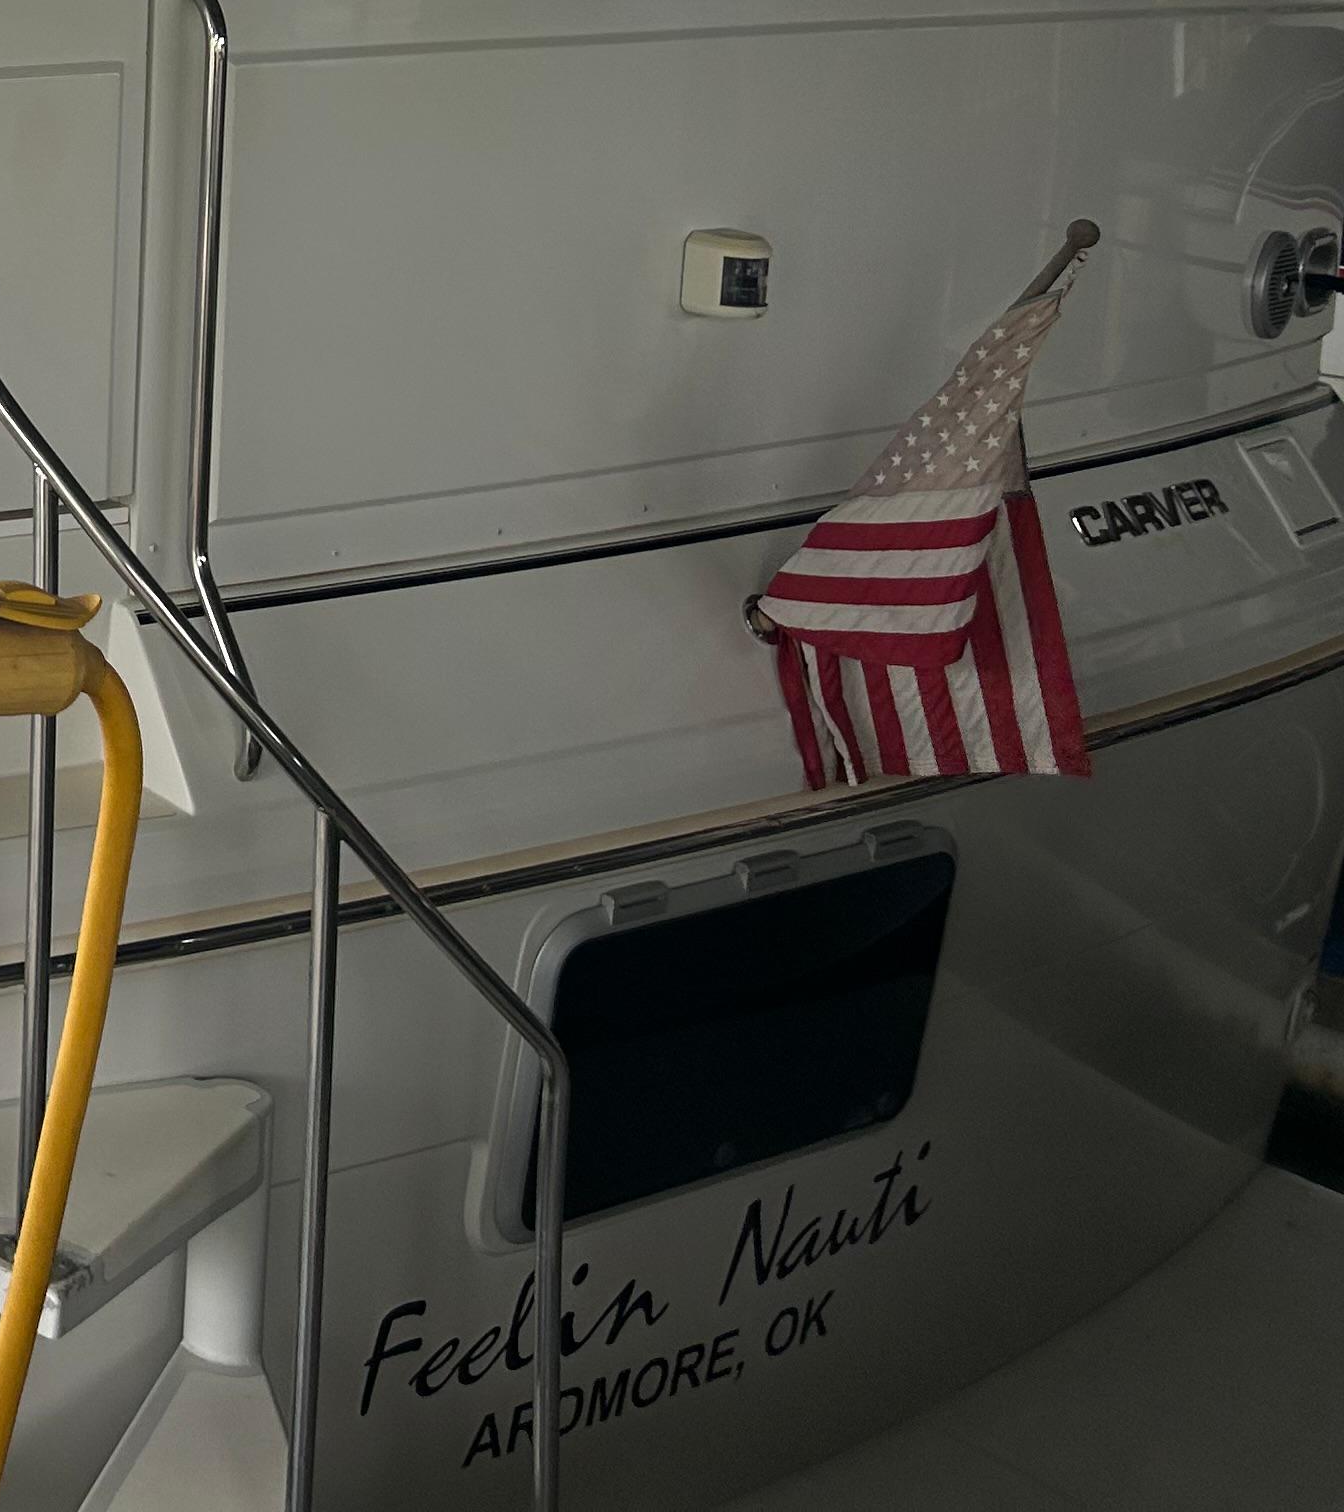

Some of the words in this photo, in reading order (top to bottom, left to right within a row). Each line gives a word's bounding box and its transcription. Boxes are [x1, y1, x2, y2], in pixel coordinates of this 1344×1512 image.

[1069, 478, 1229, 546] CARVER
[360, 1263, 668, 1416] Feelin
[719, 1141, 932, 1306] Nauti
[765, 1289, 836, 1356] OK
